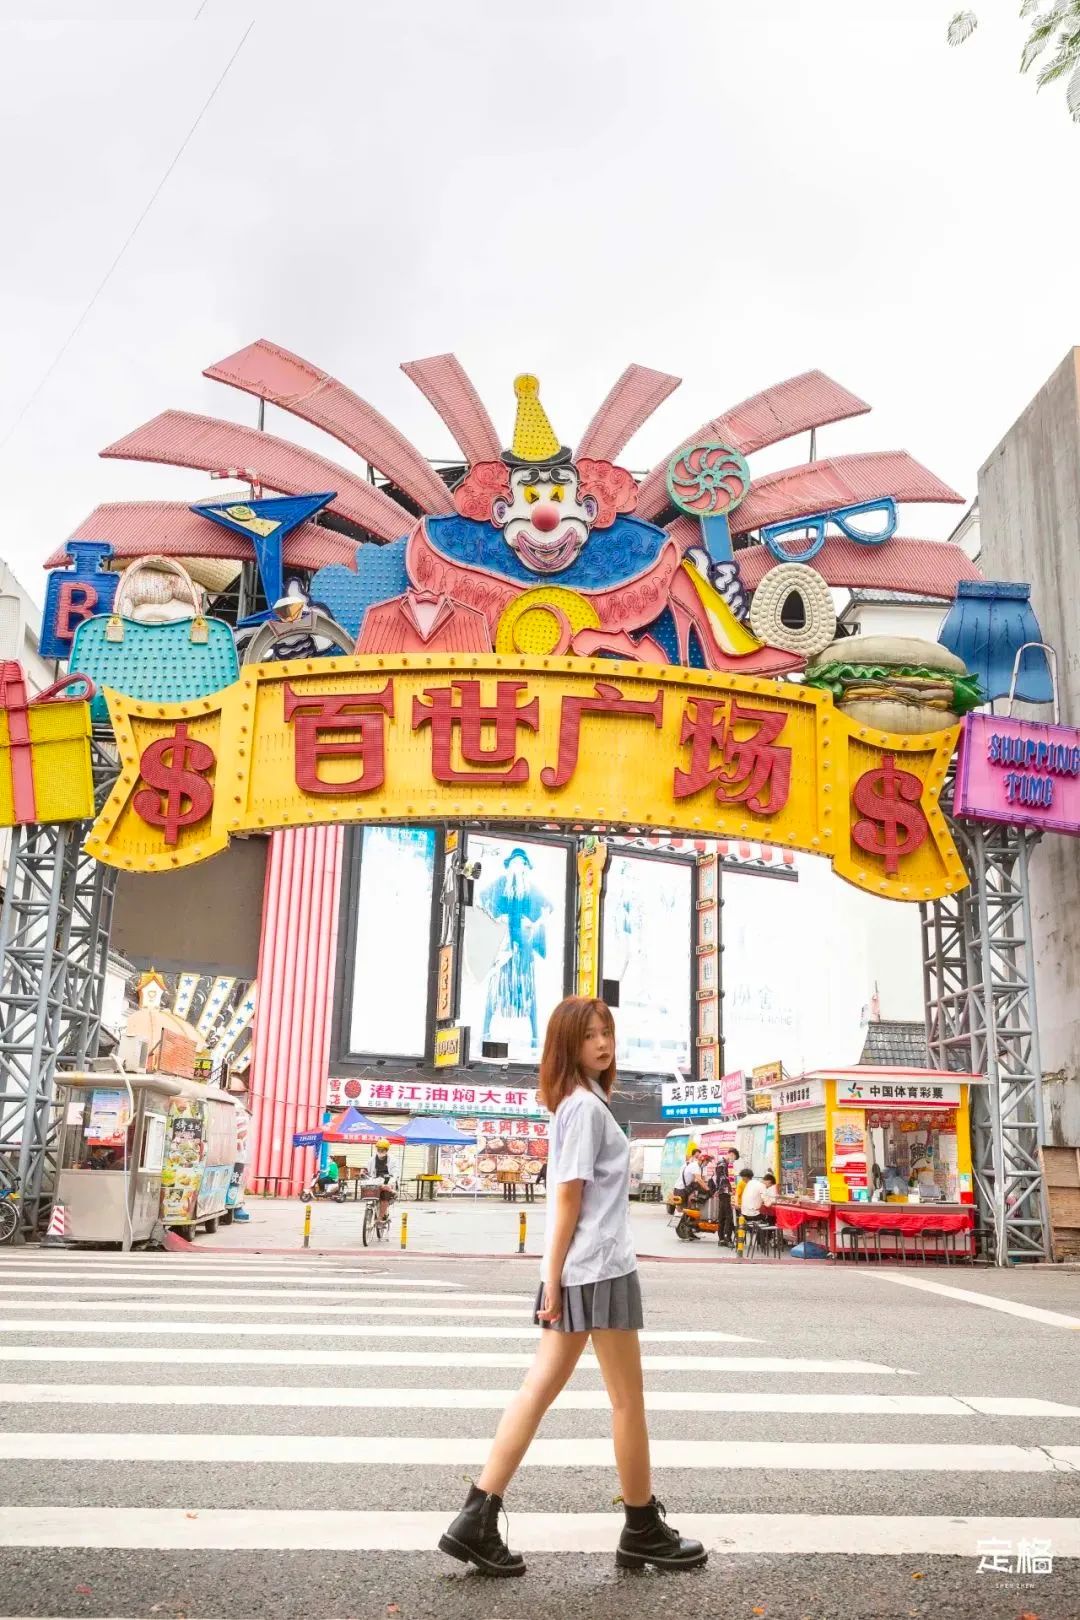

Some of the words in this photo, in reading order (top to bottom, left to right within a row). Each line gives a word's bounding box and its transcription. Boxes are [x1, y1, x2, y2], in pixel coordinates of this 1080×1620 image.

[56, 582, 100, 640] B
[283, 677, 794, 815] 百世广场
[988, 733, 1080, 776] SHOPPING
[1003, 771, 1054, 807] TIME
[369, 1083, 529, 1106] 潜江油焖大虾
[869, 1085, 944, 1099] 中国体育彩票
